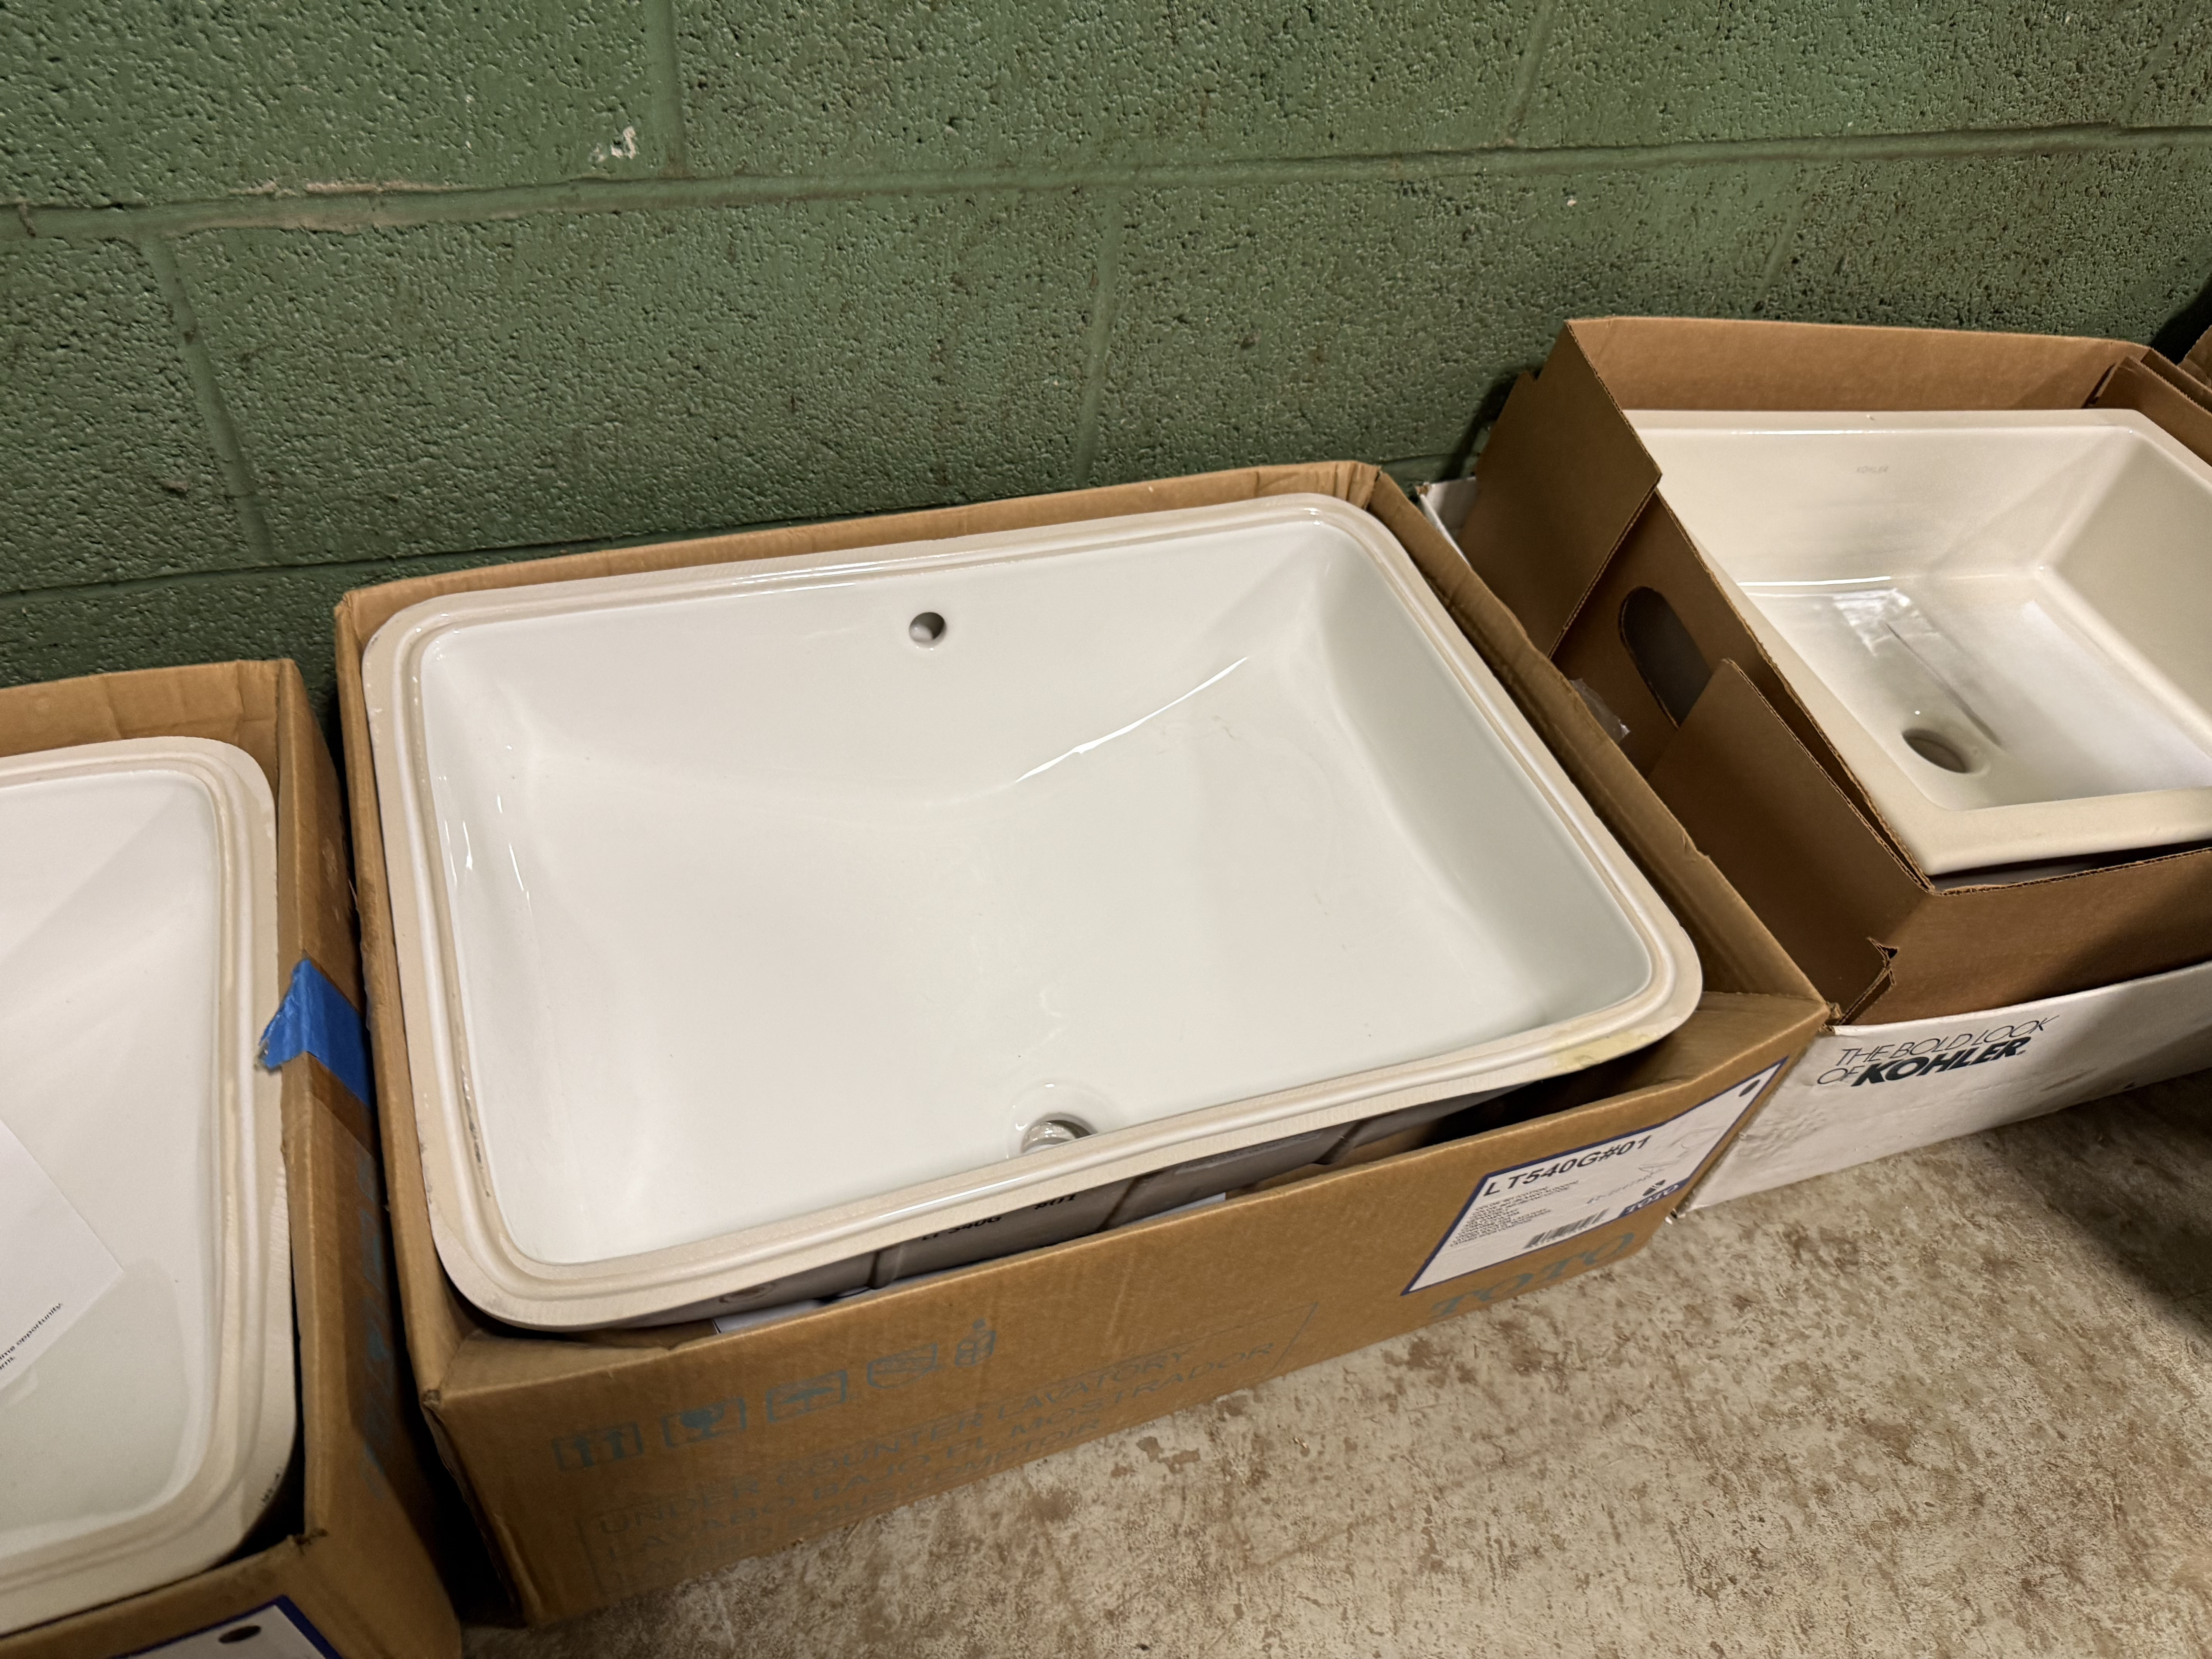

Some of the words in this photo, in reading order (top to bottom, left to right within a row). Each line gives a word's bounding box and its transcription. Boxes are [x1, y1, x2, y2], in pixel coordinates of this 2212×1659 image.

[1836, 1044, 1895, 1066] THE
[1889, 1033, 1972, 1059] BOLD
[1975, 1015, 2060, 1044] LOOK
[1817, 1065, 1865, 1084] OF
[1626, 1184, 1679, 1212] TOTO
[1430, 1232, 1635, 1316] TOTO
[16, 1303, 63, 1345] opportunity.
[776, 1410, 984, 1487] COUNTER
[995, 1343, 1197, 1421] LAVATORY
[1010, 1341, 1276, 1439] MOSTRADOR
